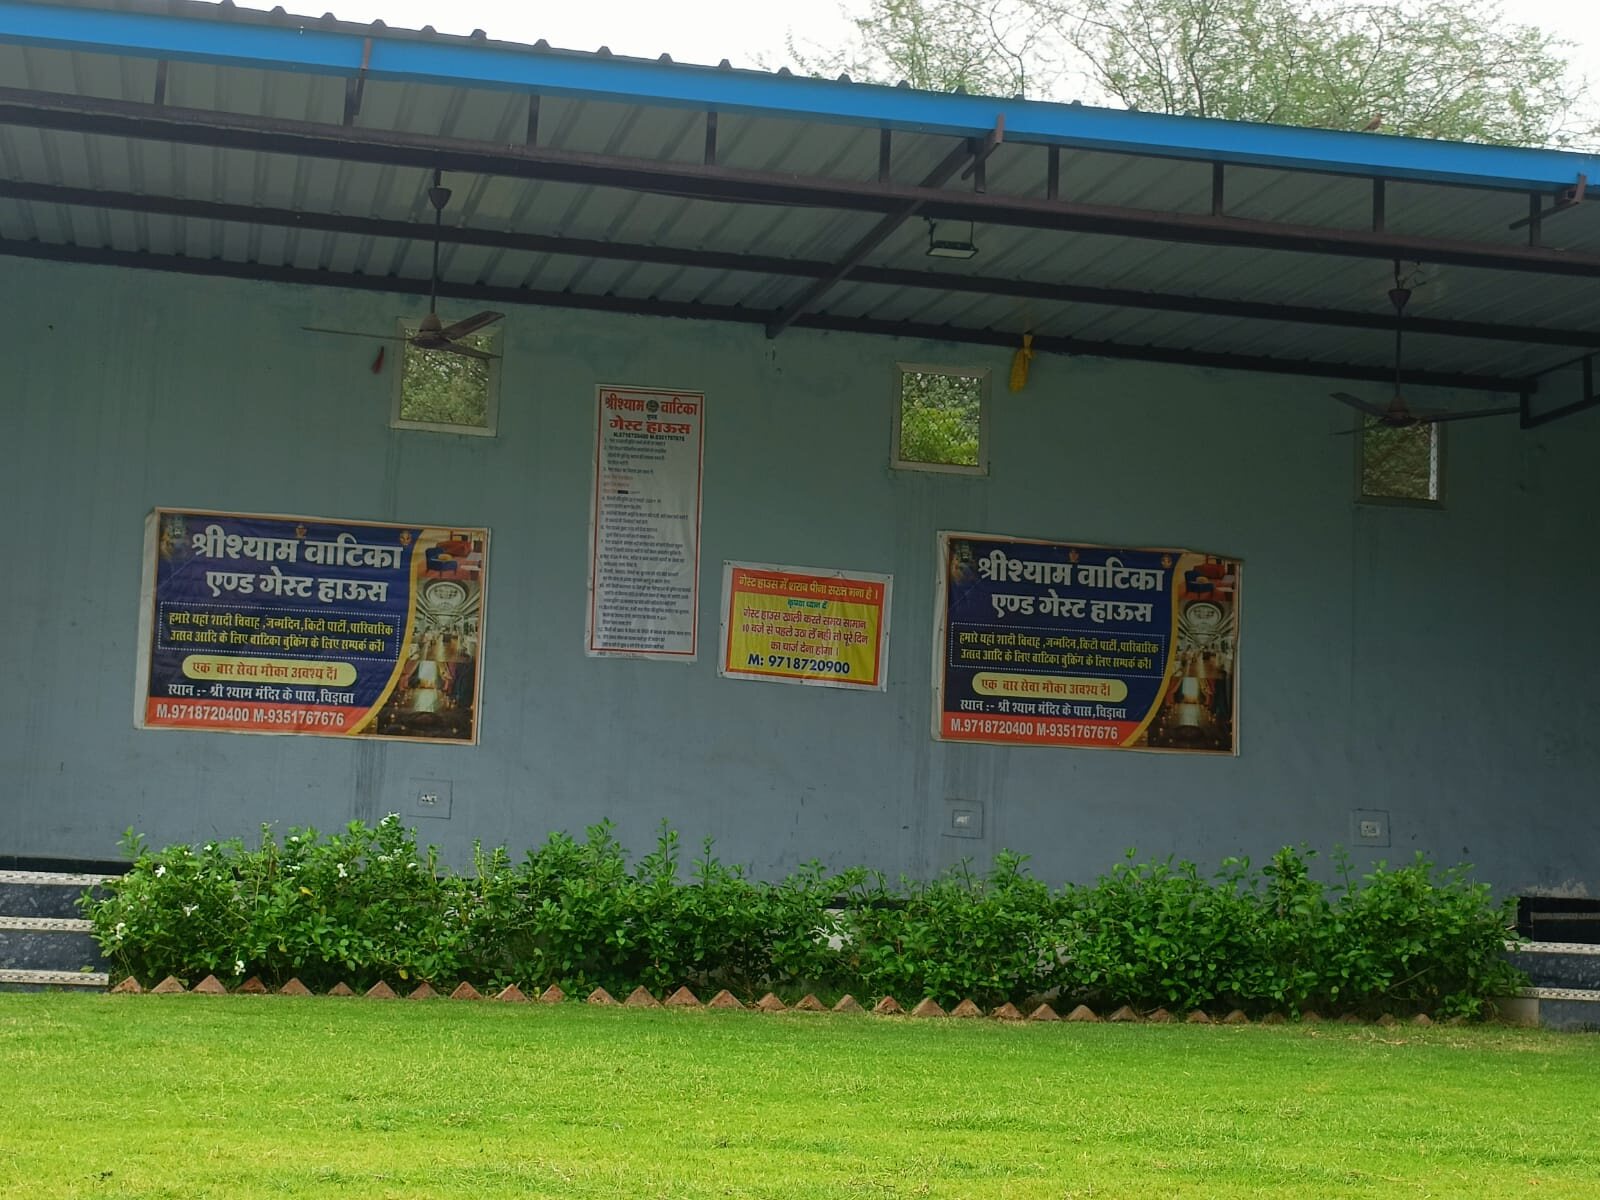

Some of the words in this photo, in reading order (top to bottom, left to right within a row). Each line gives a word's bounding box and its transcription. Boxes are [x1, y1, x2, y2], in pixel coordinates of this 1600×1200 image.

[660, 397, 697, 415] वाटिका
[609, 415, 642, 431] गेस्ट
[646, 421, 692, 434] हाऊस
[191, 525, 298, 563] श्रीश्याम
[304, 533, 403, 569] वाटिका
[978, 550, 1071, 586] श्रीश्याम
[1077, 557, 1164, 591] वाटिका
[206, 571, 253, 598] एण्ड
[259, 566, 313, 597] गेस्ट
[318, 579, 388, 603] हाऊस
[739, 574, 756, 587] गेस्ट
[992, 593, 1034, 618] एण्ड
[1038, 589, 1086, 618] गेस्ट
[1090, 601, 1153, 623] हाऊस
[743, 606, 760, 617] गेस्ट
[782, 611, 802, 623] खाली
[803, 615, 821, 624] करते
[843, 618, 866, 629] सामान
[219, 631, 228, 643] के
[310, 636, 319, 648] के
[833, 630, 842, 642] तो
[854, 632, 868, 645] दिन
[771, 642, 781, 651] का
[800, 643, 814, 653] देना
[815, 644, 833, 656] होगा
[1004, 650, 1013, 661] के
[1086, 654, 1094, 665] के
[192, 662, 210, 673] एक
[748, 654, 764, 666] M:
[768, 655, 850, 674] 9718720900
[209, 683, 224, 697] श्री
[226, 686, 252, 699] श्याम
[255, 685, 280, 700] मंदिर
[282, 686, 293, 700] के
[981, 680, 998, 689] एक
[156, 704, 250, 722] M.9718720400
[253, 709, 345, 726] M-9351767676
[997, 700, 1010, 712] श्री
[1012, 702, 1035, 713] श्याम
[1038, 701, 1060, 714] मंदिर
[1062, 704, 1072, 715] के
[951, 718, 1033, 735] M.9718720400
